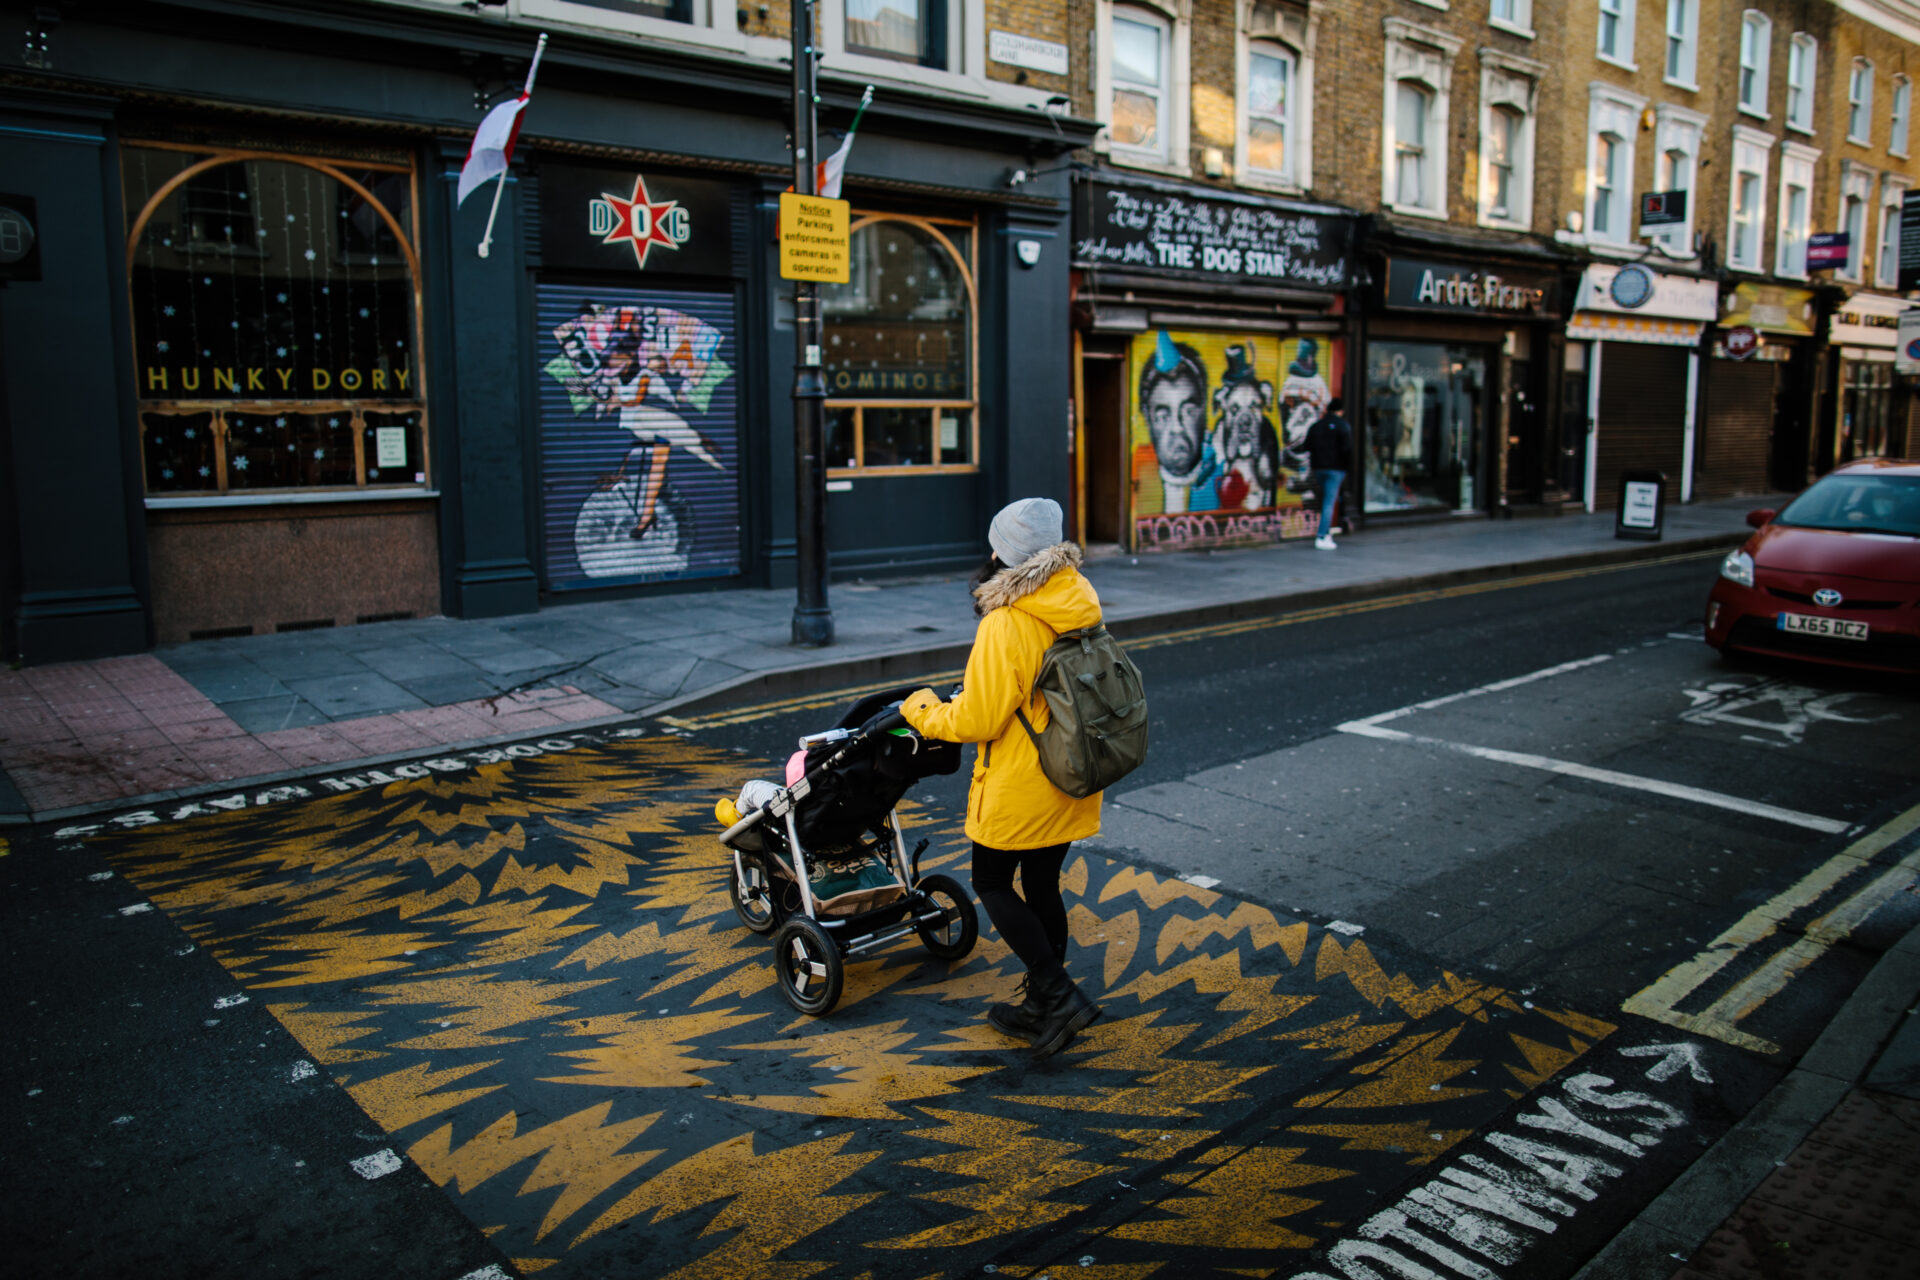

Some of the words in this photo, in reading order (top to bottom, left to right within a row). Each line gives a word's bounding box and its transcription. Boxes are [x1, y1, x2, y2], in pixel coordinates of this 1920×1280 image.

[800, 203, 831, 215] Notice
[589, 199, 690, 243] DOG
[797, 217, 834, 232] Parking
[784, 232, 846, 246] enforcement
[789, 248, 829, 260] cameras
[832, 252, 841, 260] in
[1154, 242, 1194, 268] THE
[1202, 245, 1242, 273] DOG
[1245, 250, 1285, 277] STAR
[792, 264, 838, 275] operation
[1418, 269, 1480, 307] André
[148, 367, 293, 391] HUNKY
[312, 368, 410, 391] DORY
[1787, 616, 1829, 633] LX65
[1834, 622, 1867, 638] DCZ
[319, 758, 466, 791] BOTH
